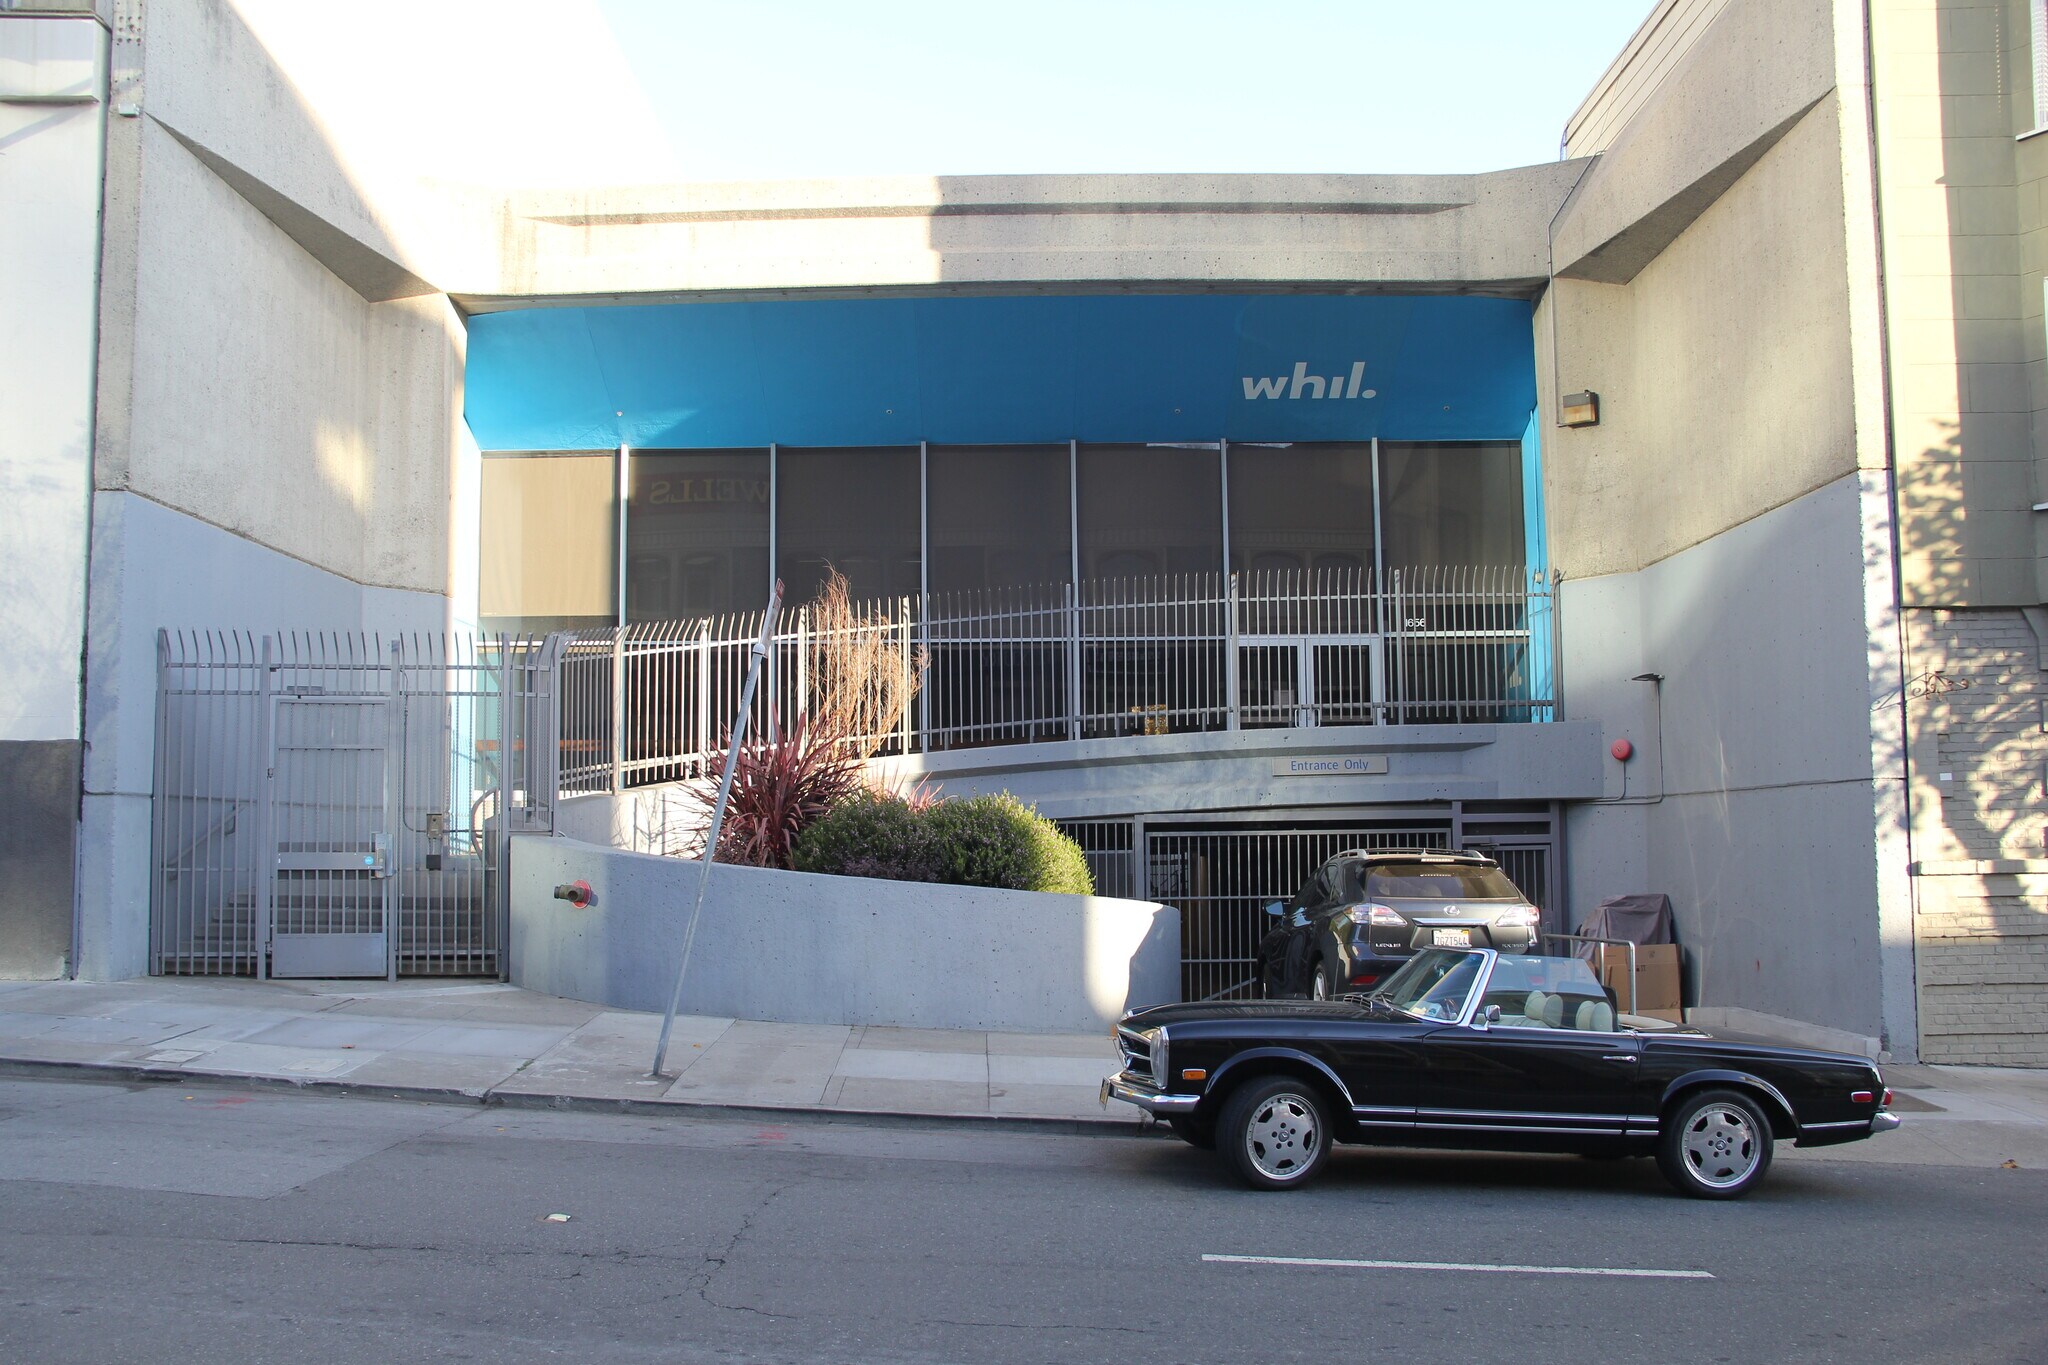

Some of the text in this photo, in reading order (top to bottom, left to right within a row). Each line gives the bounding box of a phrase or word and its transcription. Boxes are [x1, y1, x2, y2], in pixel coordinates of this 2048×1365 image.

[1242, 361, 1377, 400] whil.
[1405, 618, 1425, 628] 1656
[1291, 759, 1369, 771] Entrance Only
